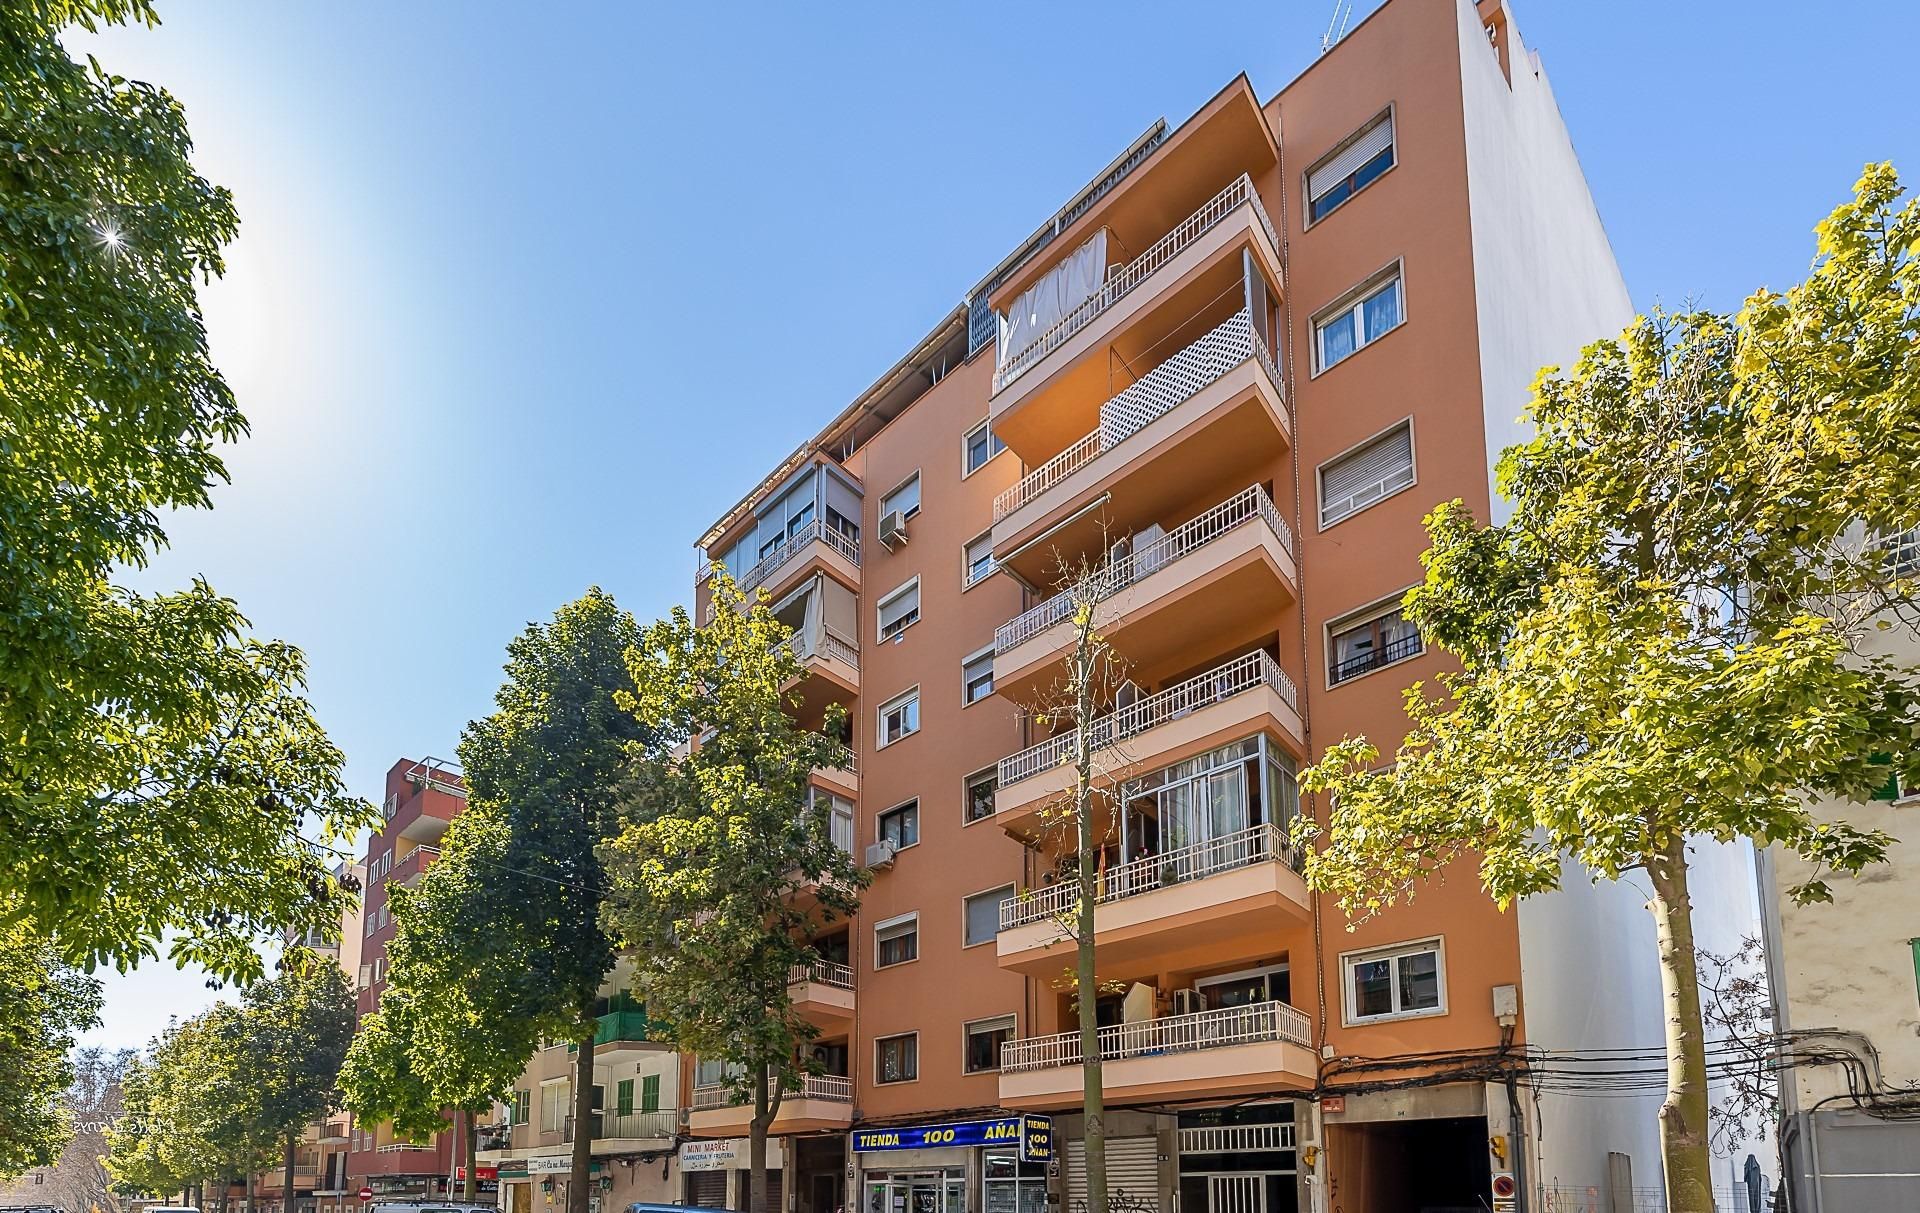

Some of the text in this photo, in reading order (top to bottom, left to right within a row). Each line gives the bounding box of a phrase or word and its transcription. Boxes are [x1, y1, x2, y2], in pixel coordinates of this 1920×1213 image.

[1026, 1119, 1050, 1131] TIENDA
[860, 1133, 900, 1148] TIENDA
[922, 1129, 955, 1144] 100
[1029, 1134, 1048, 1144] 100
[687, 1143, 729, 1153] MINI MARKET
